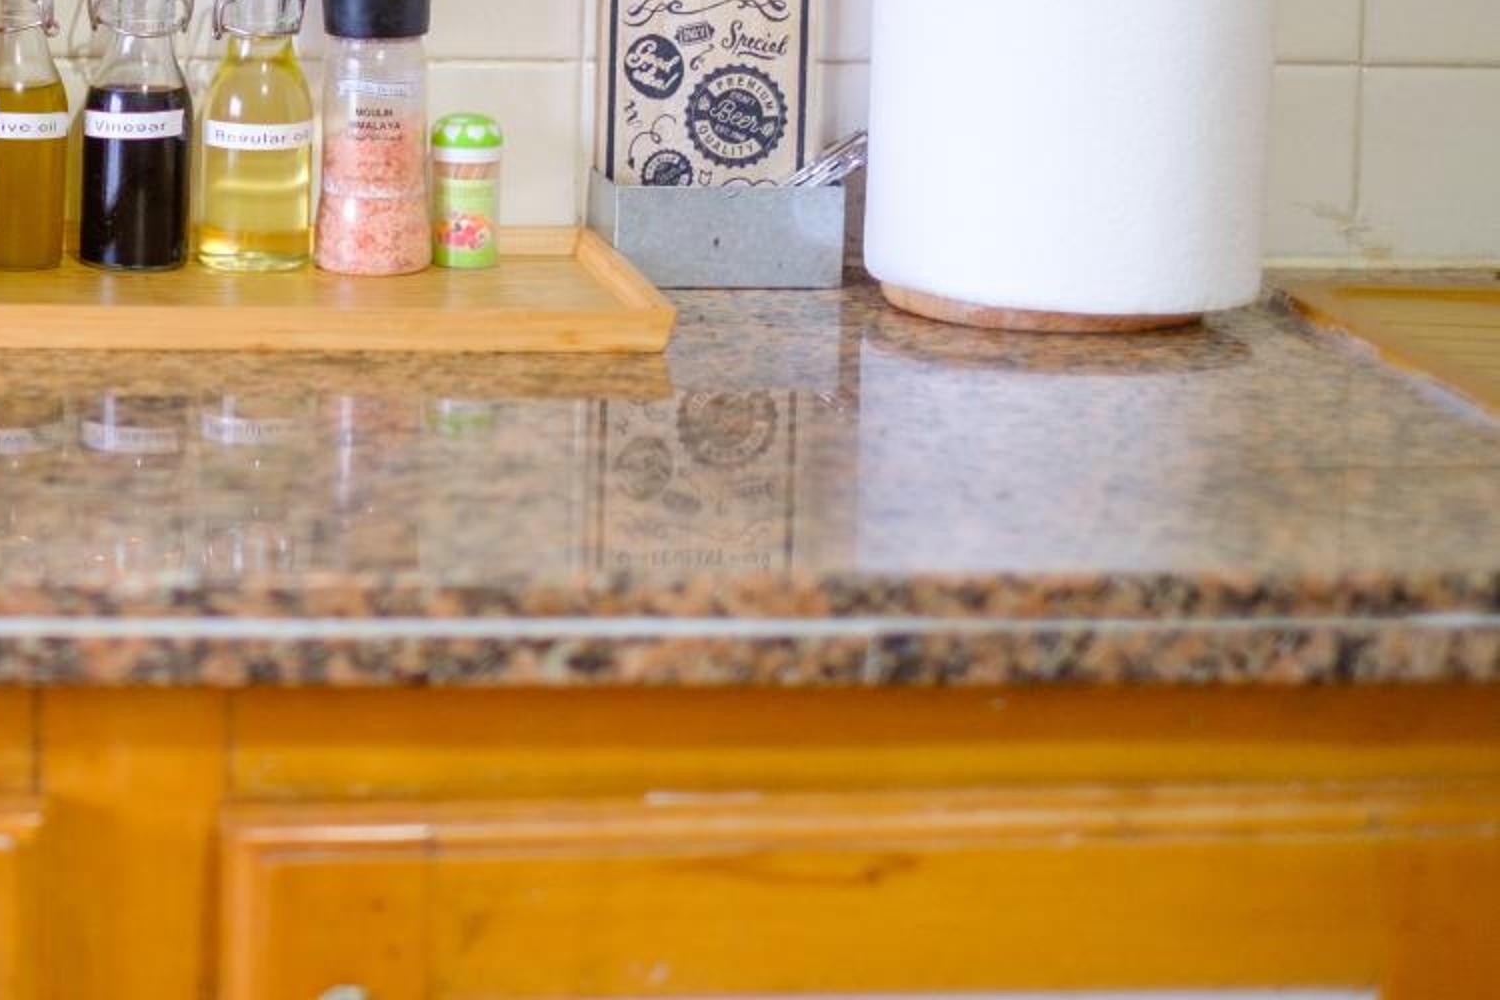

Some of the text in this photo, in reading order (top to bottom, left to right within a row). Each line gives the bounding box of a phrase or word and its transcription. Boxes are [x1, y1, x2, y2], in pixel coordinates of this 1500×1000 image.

[721, 20, 789, 58] Special
[716, 76, 774, 111] PREMIUM
[37, 120, 57, 133] oil
[95, 119, 165, 133] Vinegar
[349, 120, 401, 130] MALAYA
[709, 99, 760, 134] Beer
[699, 124, 754, 156] QUALITY
